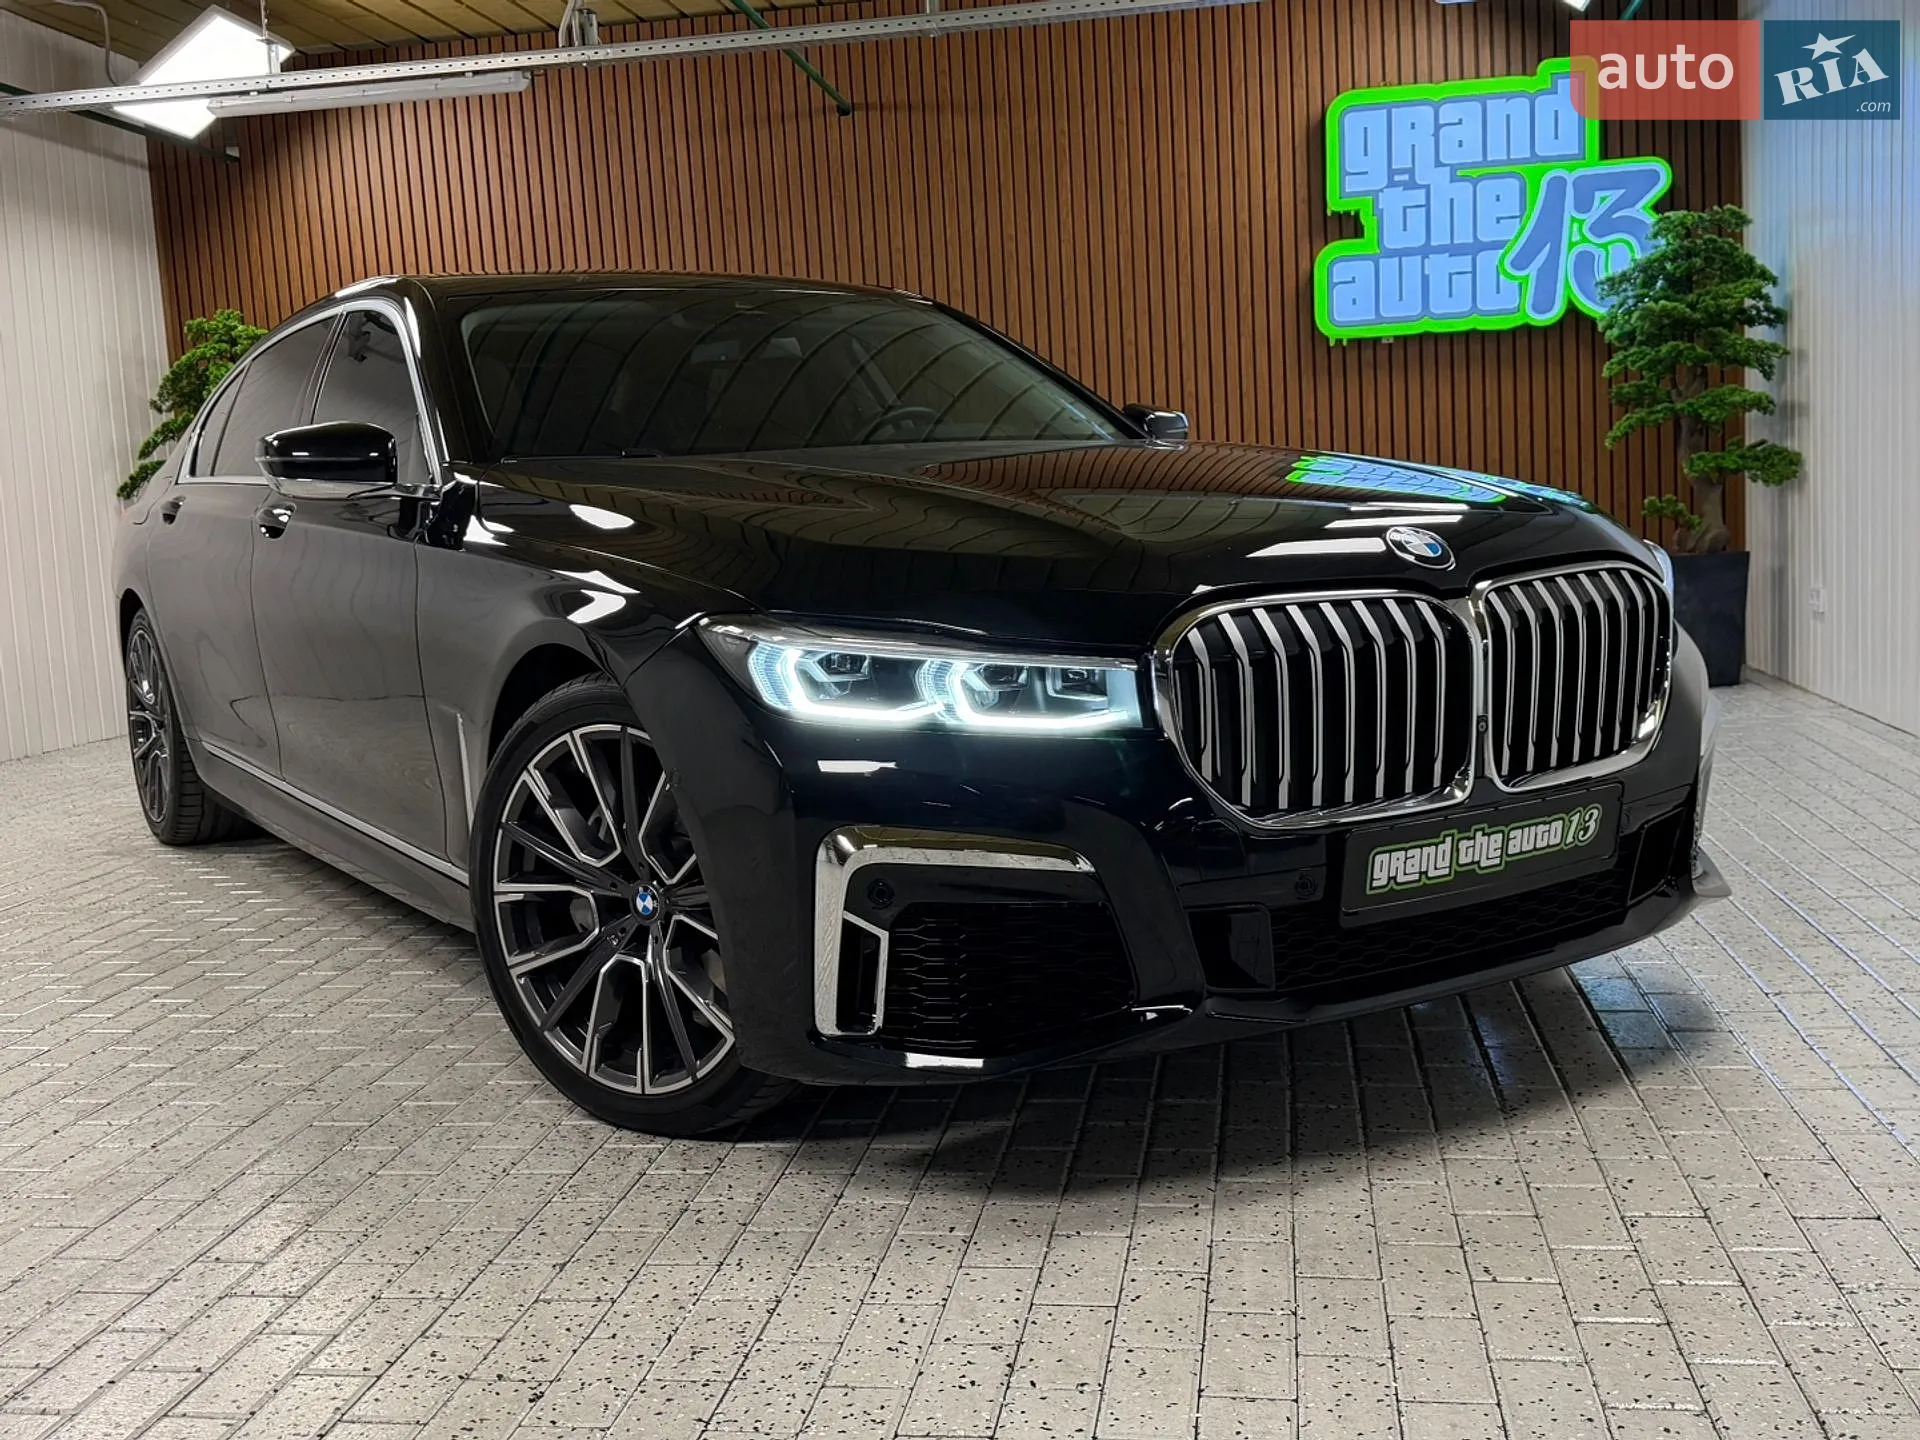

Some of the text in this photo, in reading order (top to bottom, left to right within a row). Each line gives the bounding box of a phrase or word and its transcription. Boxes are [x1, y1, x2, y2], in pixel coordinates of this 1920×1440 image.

[1380, 167, 1521, 248] the
[1332, 250, 1521, 322] auto
[1458, 829, 1504, 868] the
